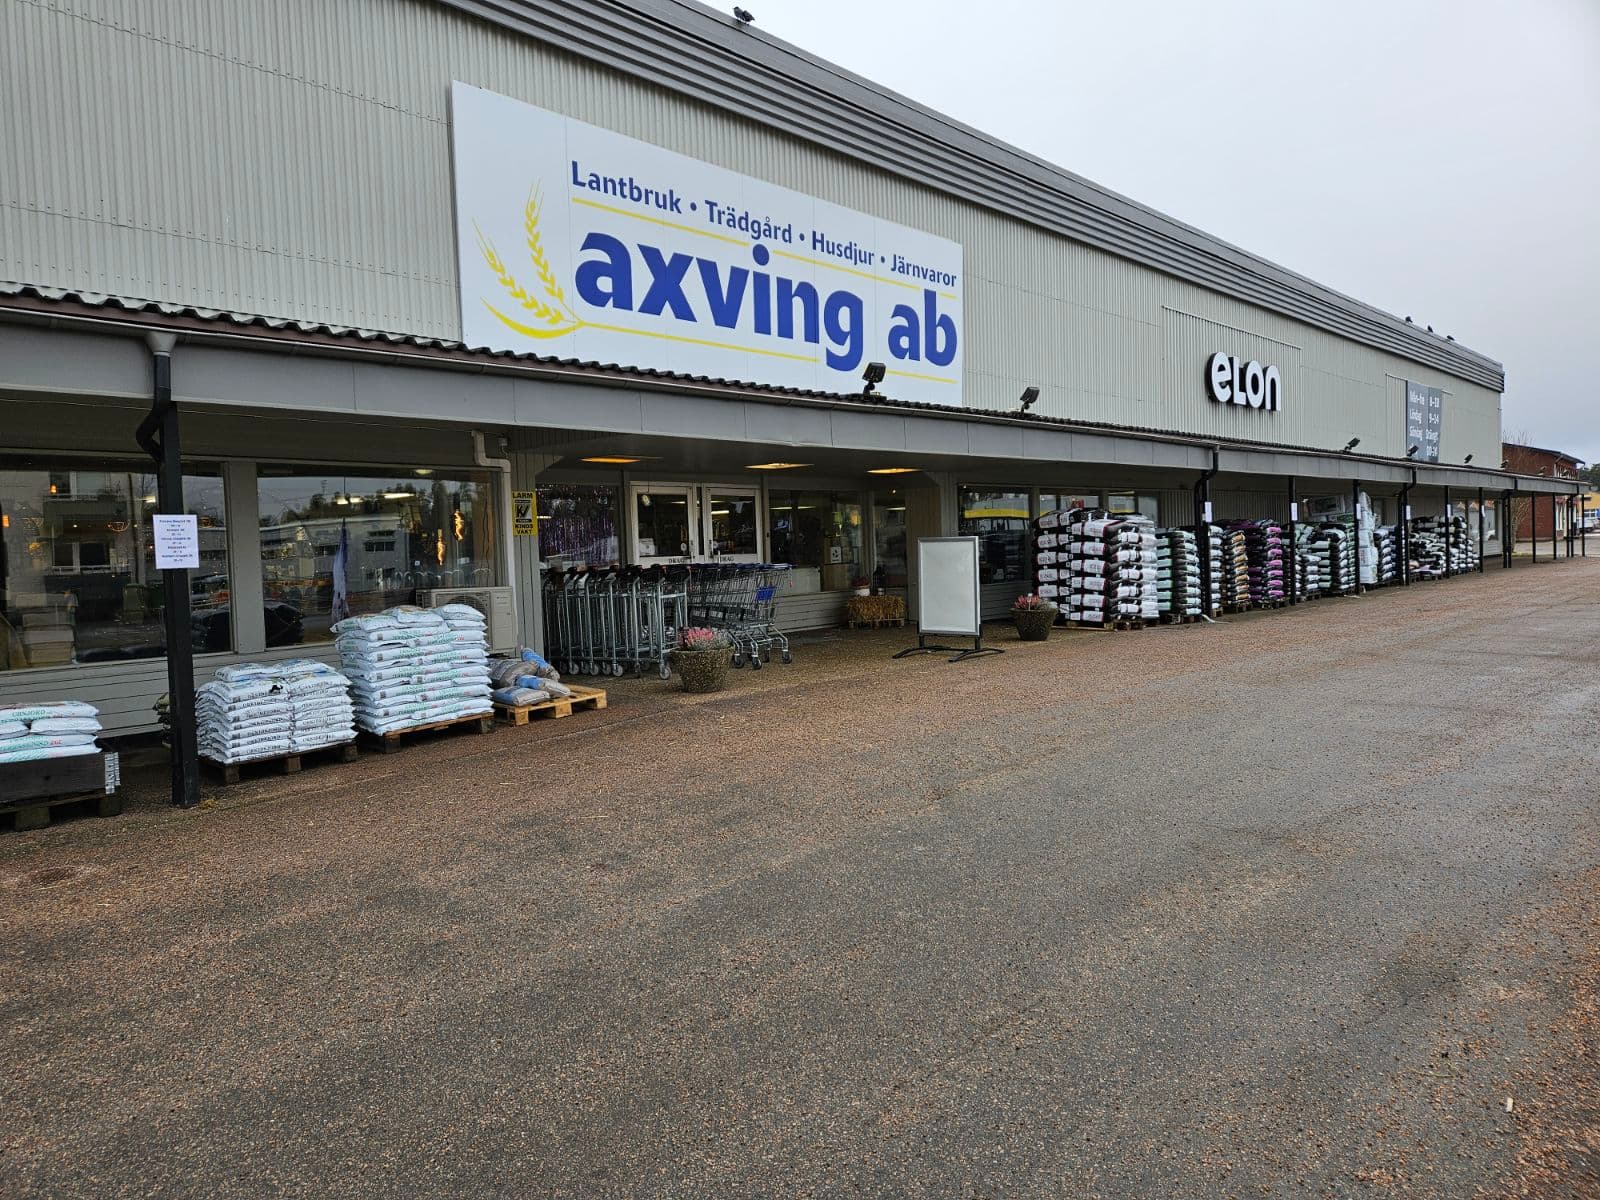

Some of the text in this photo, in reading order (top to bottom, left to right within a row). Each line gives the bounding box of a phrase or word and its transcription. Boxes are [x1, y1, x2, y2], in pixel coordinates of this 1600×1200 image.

[571, 160, 957, 287] Lantbruk Trädgård Husdjur Järnvaror
[575, 231, 957, 372] axving ab
